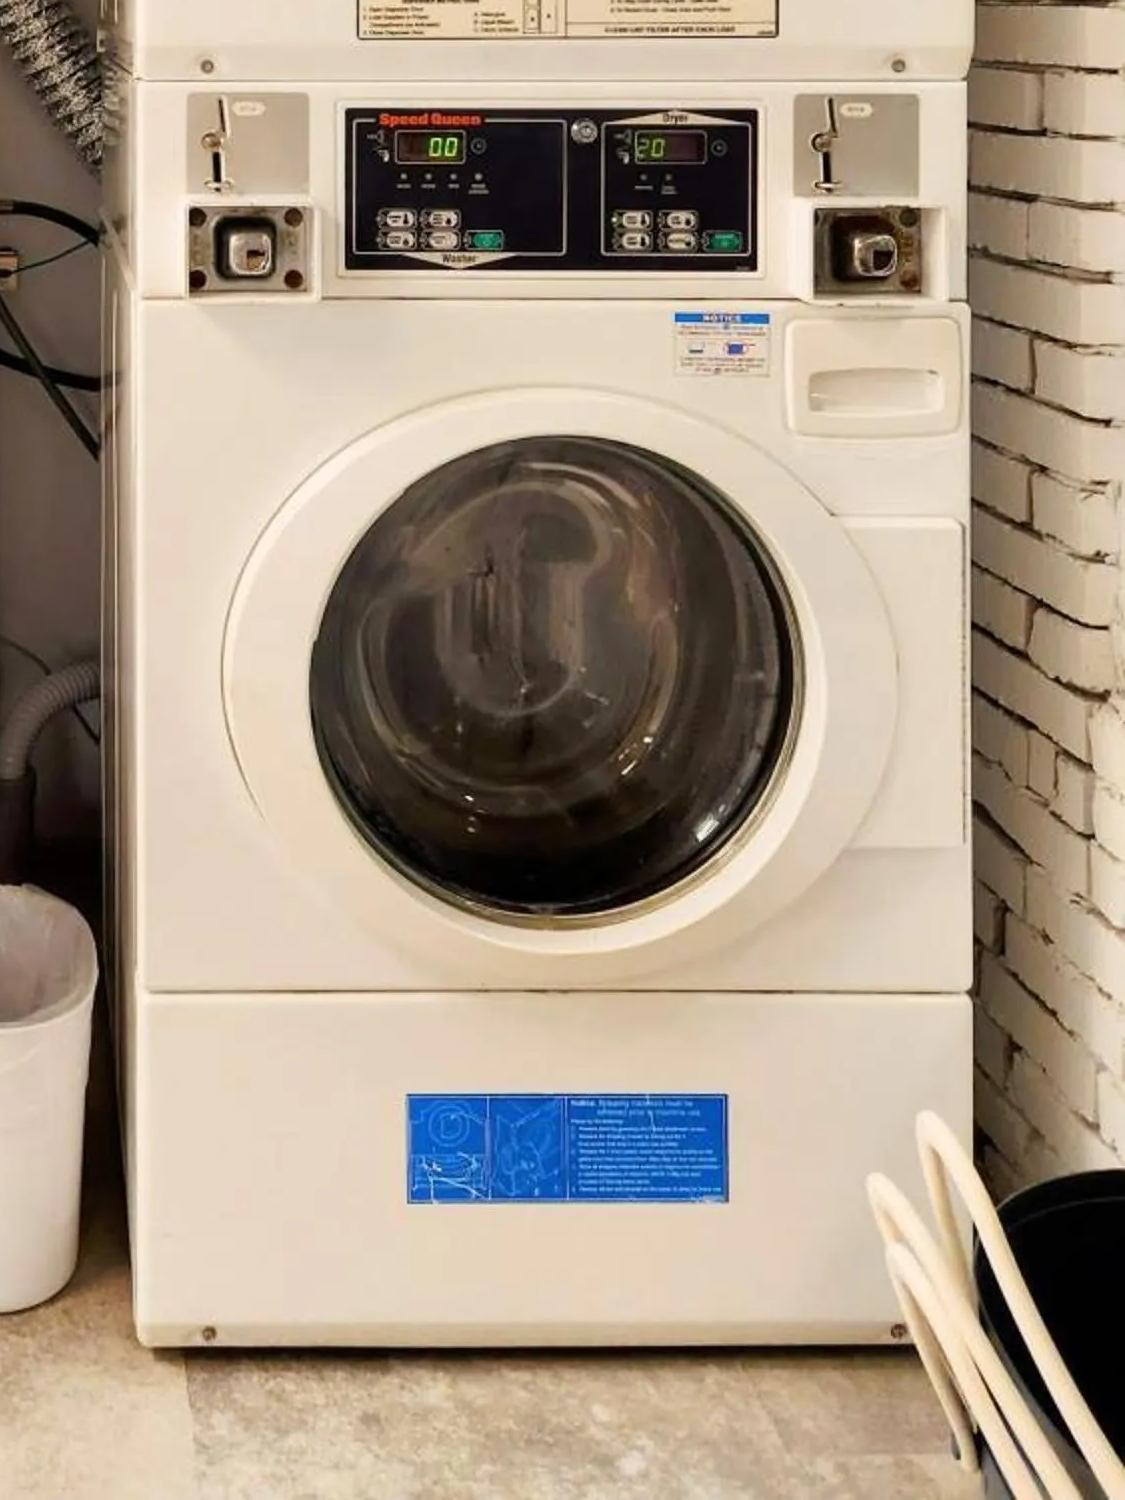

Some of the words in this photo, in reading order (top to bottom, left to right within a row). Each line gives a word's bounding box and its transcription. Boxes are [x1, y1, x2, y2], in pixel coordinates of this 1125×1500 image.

[379, 112, 428, 127] Speed
[431, 112, 482, 125] Queen
[662, 113, 688, 124] Dryer
[428, 137, 459, 157] 00
[637, 138, 666, 158] 20
[442, 254, 478, 263] Washer
